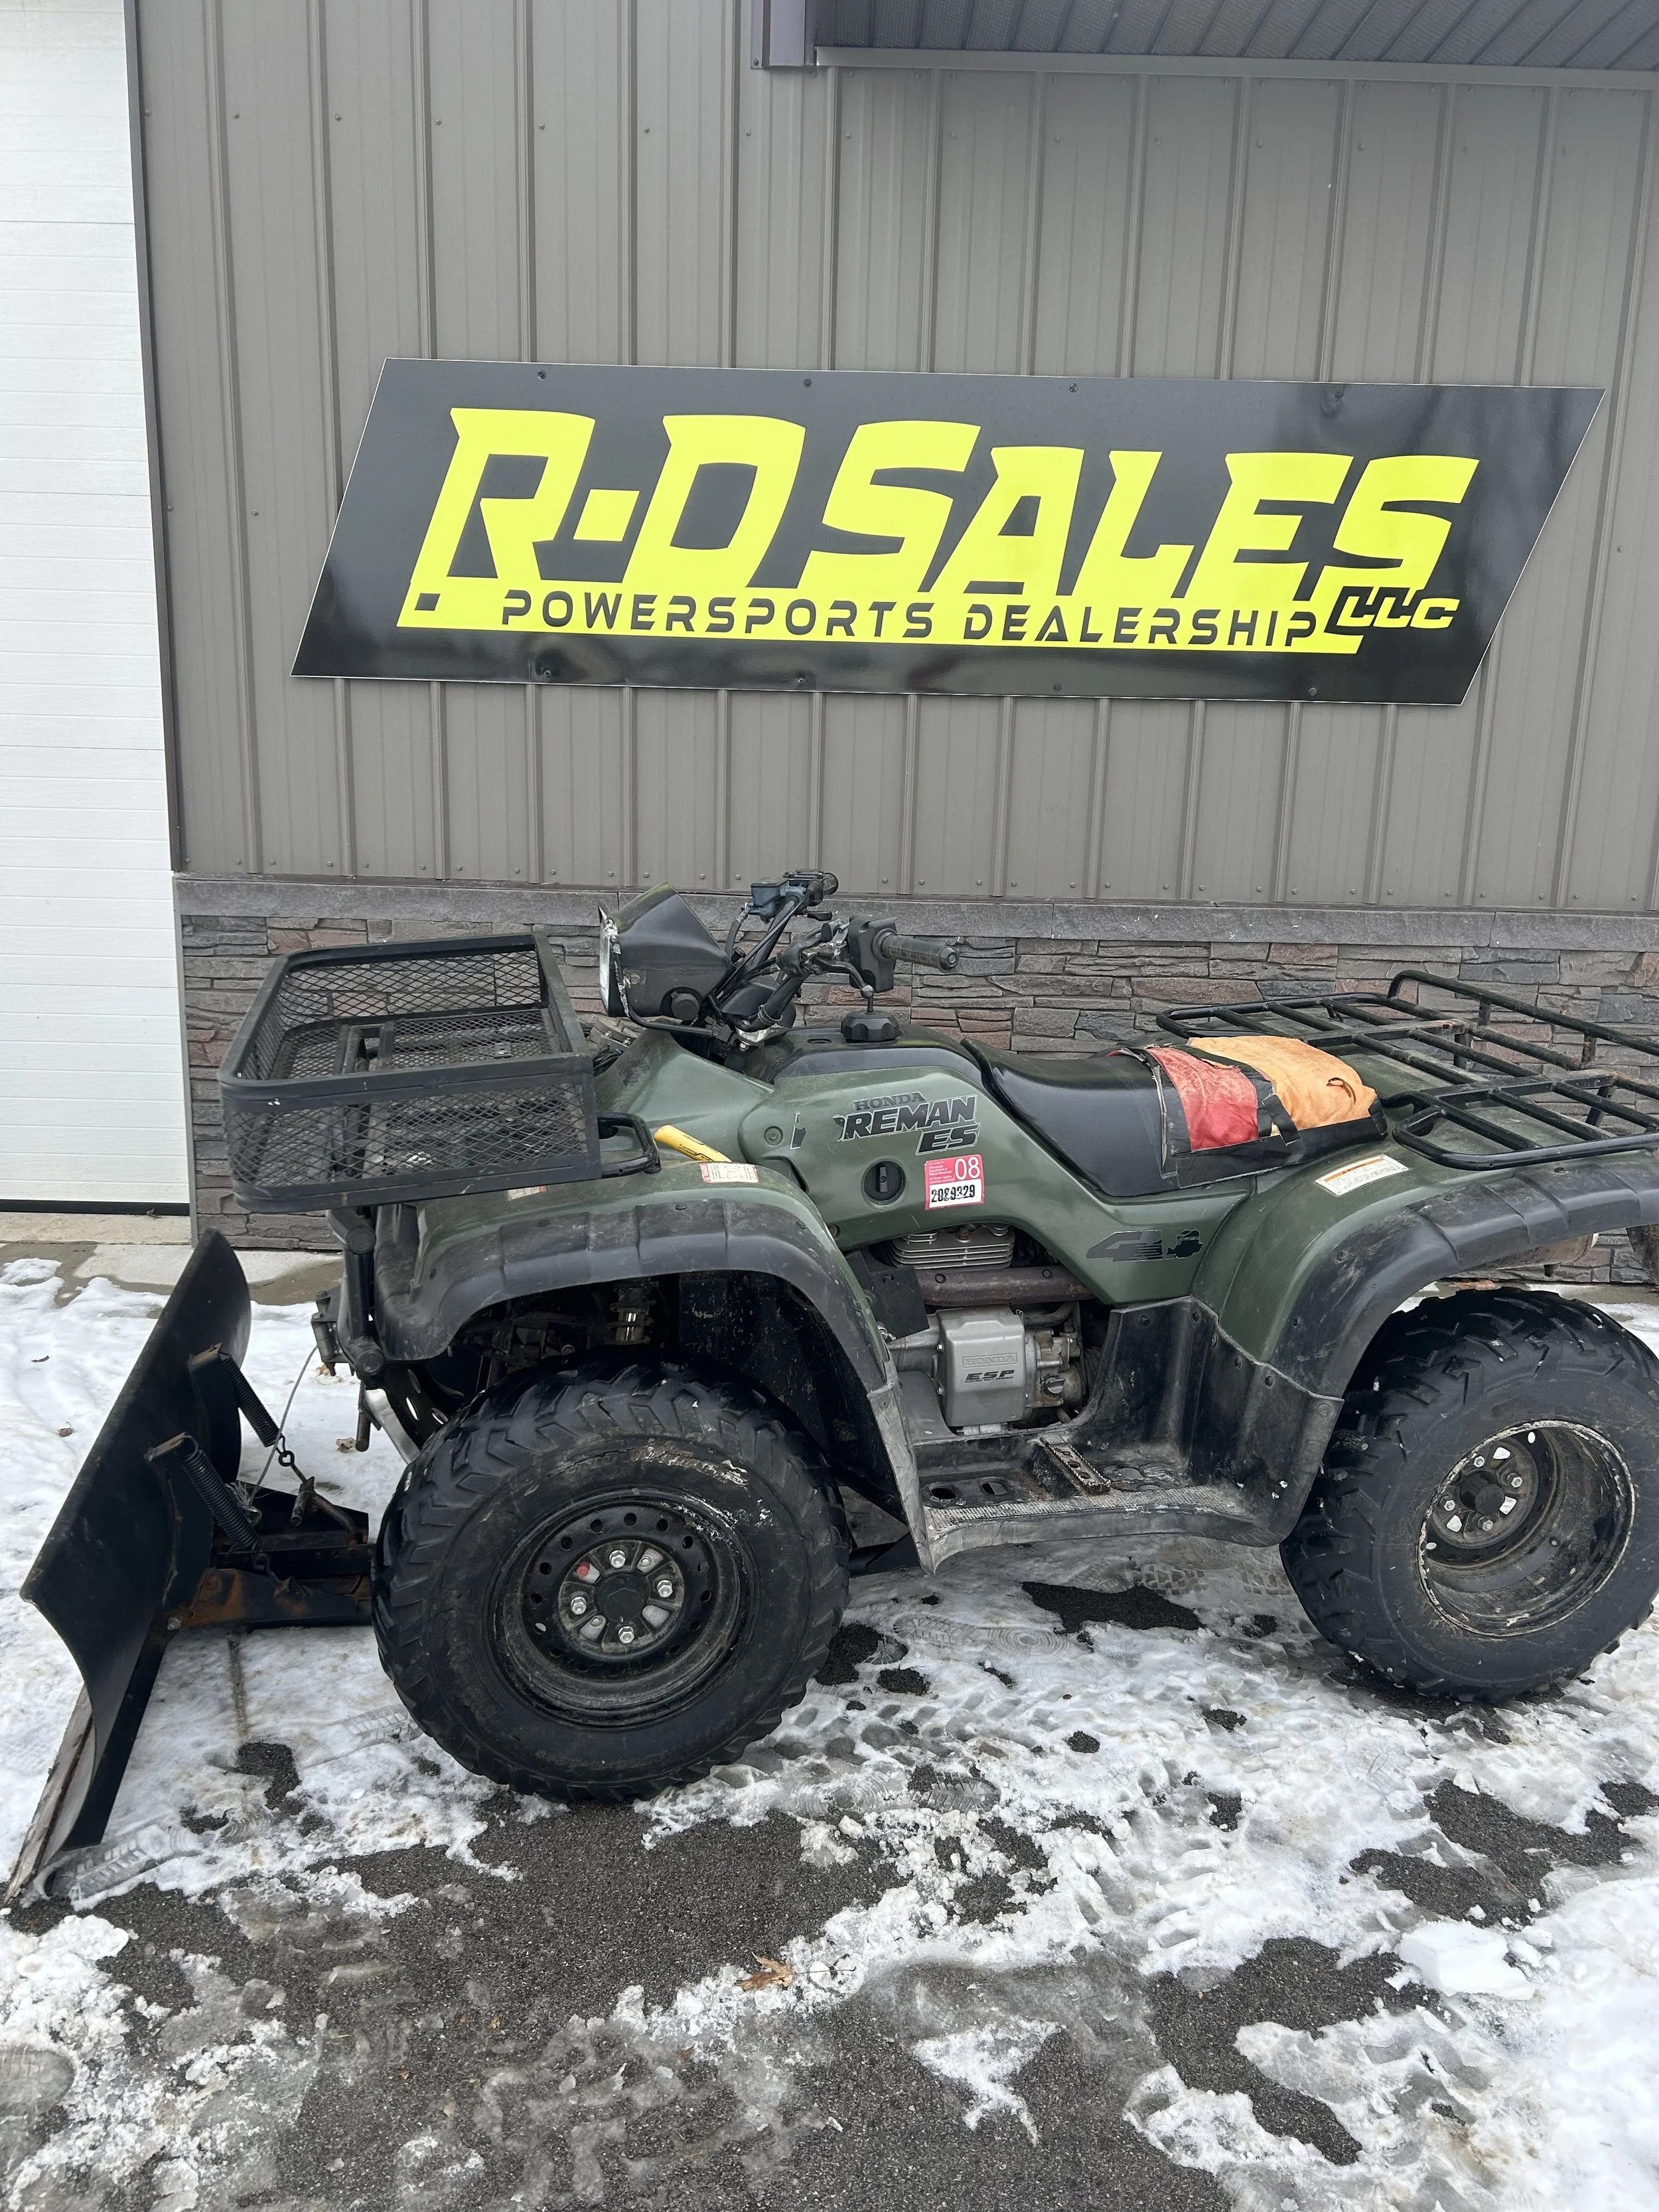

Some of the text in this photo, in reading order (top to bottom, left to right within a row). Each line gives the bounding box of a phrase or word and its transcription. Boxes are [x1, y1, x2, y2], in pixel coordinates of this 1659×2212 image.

[796, 419, 1480, 601] SALES
[501, 589, 1317, 647] POWERSPORTS DEALERSHIP
[1335, 595, 1461, 630] LLC
[855, 1092, 926, 1111] HONDA
[790, 1095, 977, 1149] REMAN
[917, 1123, 981, 1154] ES
[954, 1156, 981, 1181] 08
[964, 1355, 1016, 1366] HONDA
[965, 1369, 1015, 1381] ESP
